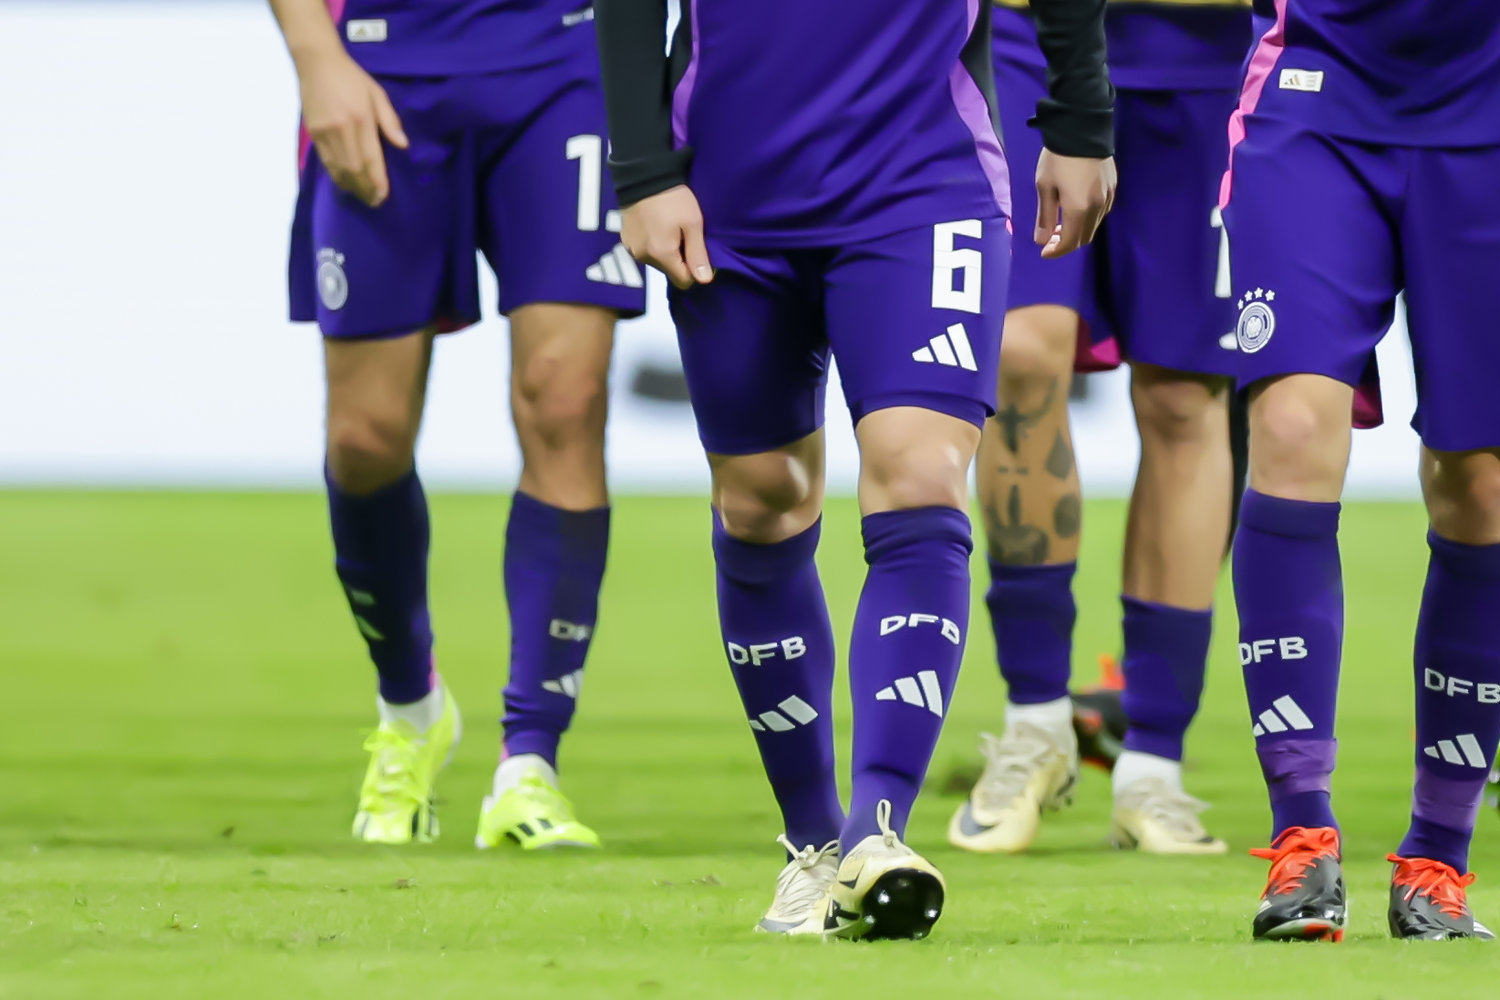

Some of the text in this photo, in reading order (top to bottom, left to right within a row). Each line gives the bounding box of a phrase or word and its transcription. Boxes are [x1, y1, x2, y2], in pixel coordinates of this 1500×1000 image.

[565, 133, 623, 233] 1
[931, 218, 983, 314] 6
[880, 613, 960, 645] DFB
[728, 636, 807, 666] DFB
[1238, 636, 1308, 666] DFB
